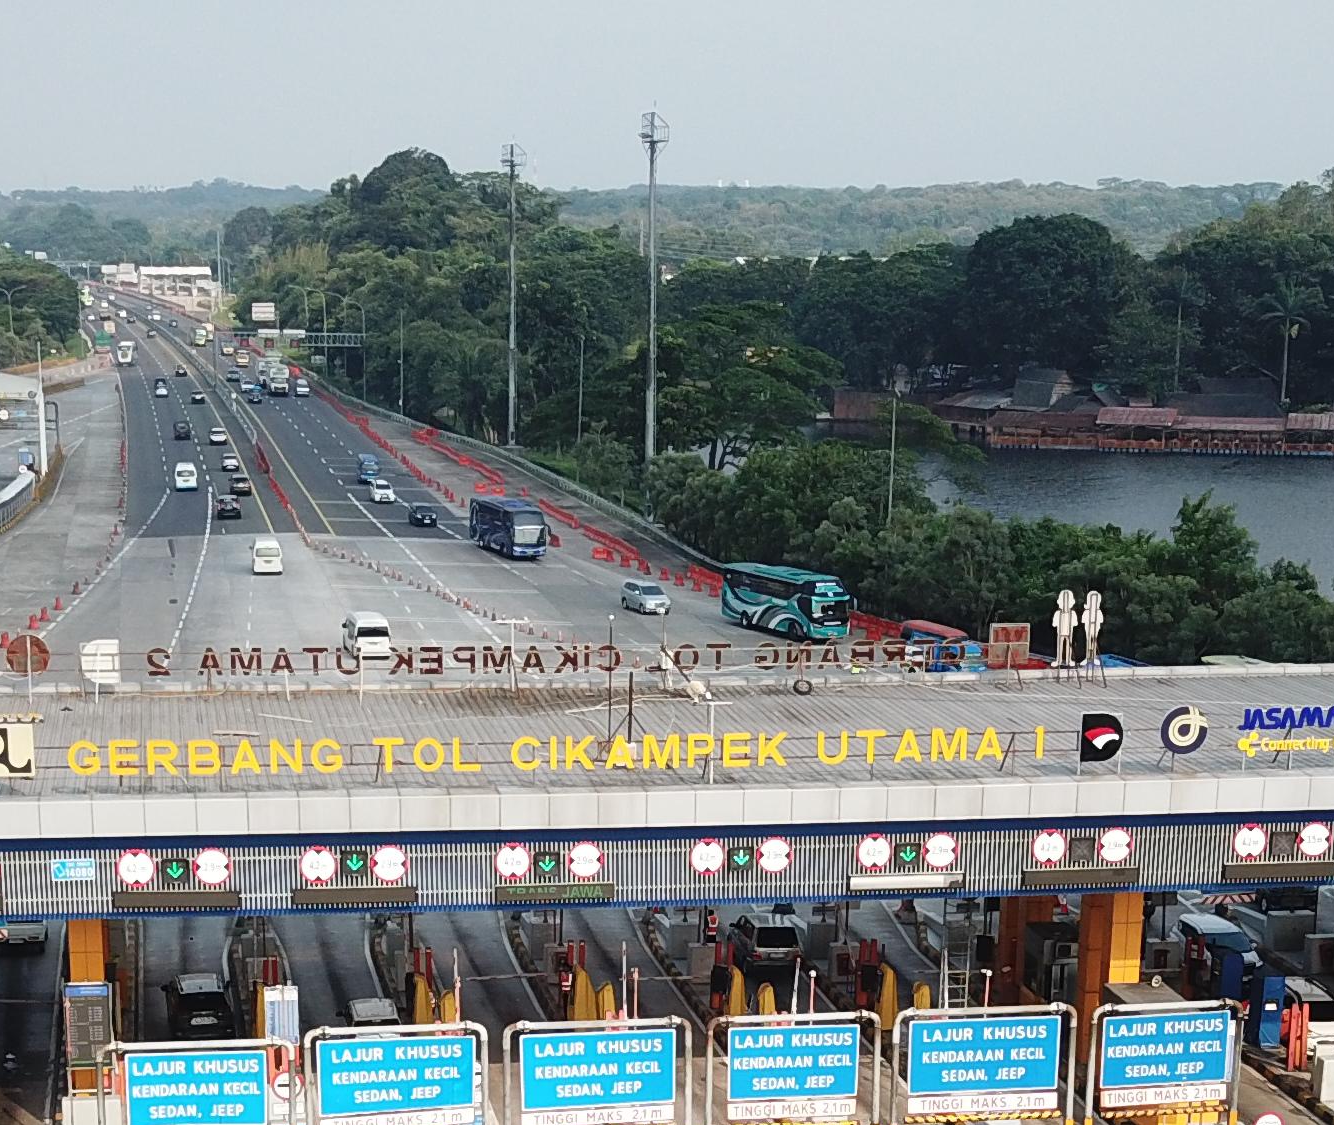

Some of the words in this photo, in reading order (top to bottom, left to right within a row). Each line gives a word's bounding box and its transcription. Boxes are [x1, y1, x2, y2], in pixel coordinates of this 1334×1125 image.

[67, 738, 343, 775] GERBANG
[372, 736, 482, 773] TOL
[510, 731, 788, 771] CIKAMPEK
[817, 727, 1004, 766] UTAMA
[1033, 726, 1045, 760] 1
[1260, 737, 1330, 753] Connecting
[562, 886, 604, 898] JAWA
[923, 1028, 972, 1042] LAJUR
[984, 1026, 1047, 1040] KHUSUS
[1109, 1023, 1156, 1037] LAJUR
[1165, 1019, 1223, 1034] KHUSUS
[535, 1042, 584, 1058] LAJUR
[597, 1039, 662, 1054] KHUSUS
[735, 1034, 783, 1048] LAJUR
[792, 1033, 852, 1047] KHUSUS
[332, 1048, 383, 1063] LAJUR
[396, 1045, 462, 1059] KHUSUS
[923, 1049, 1004, 1063] KENDARAAN
[1011, 1048, 1045, 1060] KECIL
[1107, 1043, 1183, 1058] KENDARAAN
[1190, 1041, 1222, 1053] KECIL
[133, 1061, 185, 1076] LAJUR
[194, 1059, 259, 1074] KHUSUS
[535, 1063, 617, 1079] KENDARAAN
[626, 1061, 661, 1074] KECIL
[734, 1056, 812, 1070] KENDARAAN
[819, 1055, 853, 1067] KECIL
[1125, 1064, 1171, 1078] SEDAN,
[1175, 1062, 1204, 1074] JEEP
[332, 1069, 416, 1085] KENDARAAN
[425, 1067, 460, 1080] KECIL
[752, 1077, 799, 1090] SEDAN,
[804, 1075, 834, 1088] JEEP
[941, 1069, 987, 1082] SEDAN,
[995, 1067, 1025, 1079] JEEP
[132, 1083, 218, 1098] KENDARAAN
[224, 1082, 260, 1095] KECIL
[354, 1088, 402, 1103] SEDAN,
[411, 1086, 441, 1100] JEEP
[556, 1084, 604, 1098] SEDAN,
[611, 1081, 642, 1094] JEEP
[1107, 1092, 1146, 1103] TINGGI
[1155, 1089, 1188, 1100] MAKS
[149, 1104, 202, 1119] SEDAN,
[211, 1104, 244, 1116] JEEP
[734, 1106, 775, 1117] TINGGI
[782, 1103, 816, 1114] MAKS
[922, 1099, 962, 1110] TINGGI
[971, 1097, 1007, 1108] MAKS
[534, 1114, 577, 1125] TINGGI
[587, 1111, 622, 1122] MAKS
